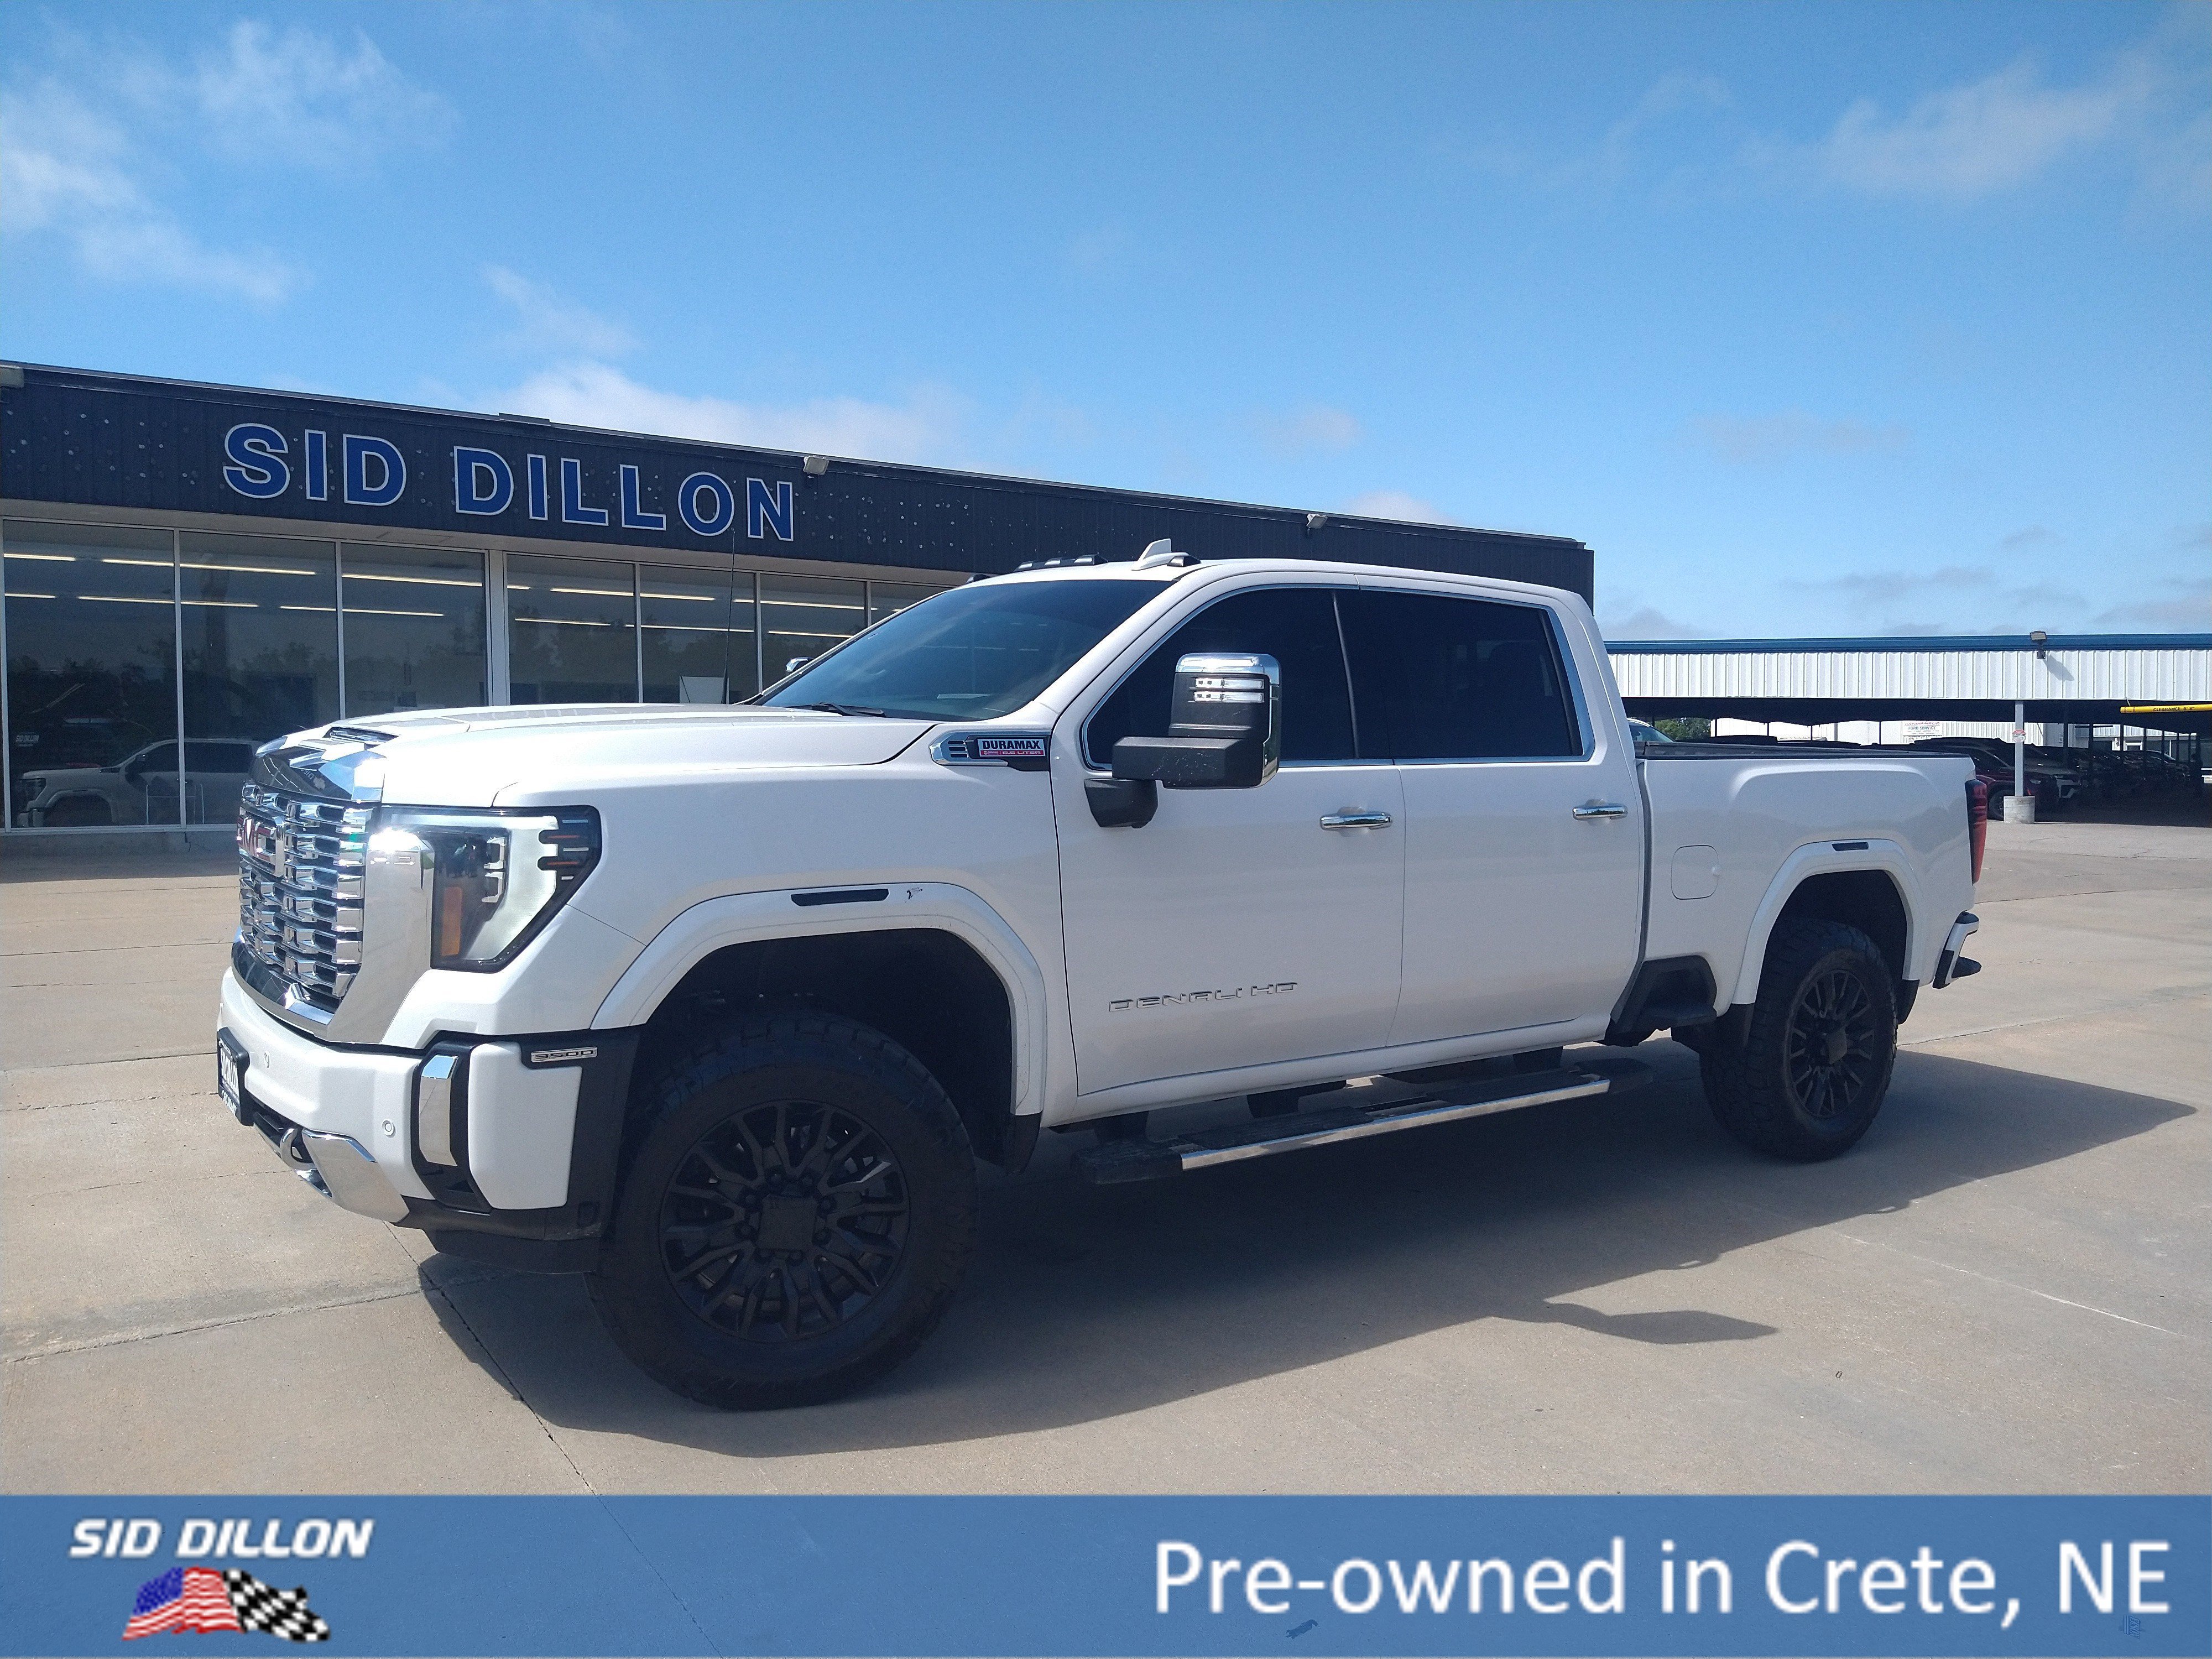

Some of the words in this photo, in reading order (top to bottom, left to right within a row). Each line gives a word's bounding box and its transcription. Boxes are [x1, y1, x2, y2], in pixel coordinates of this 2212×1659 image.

[222, 422, 407, 507] SID
[453, 445, 794, 542] DILLON
[982, 740, 1041, 749] DURAMAX
[1109, 987, 1243, 1012] DENALI
[1251, 982, 1298, 997] HD
[535, 1050, 594, 1061] 3500
